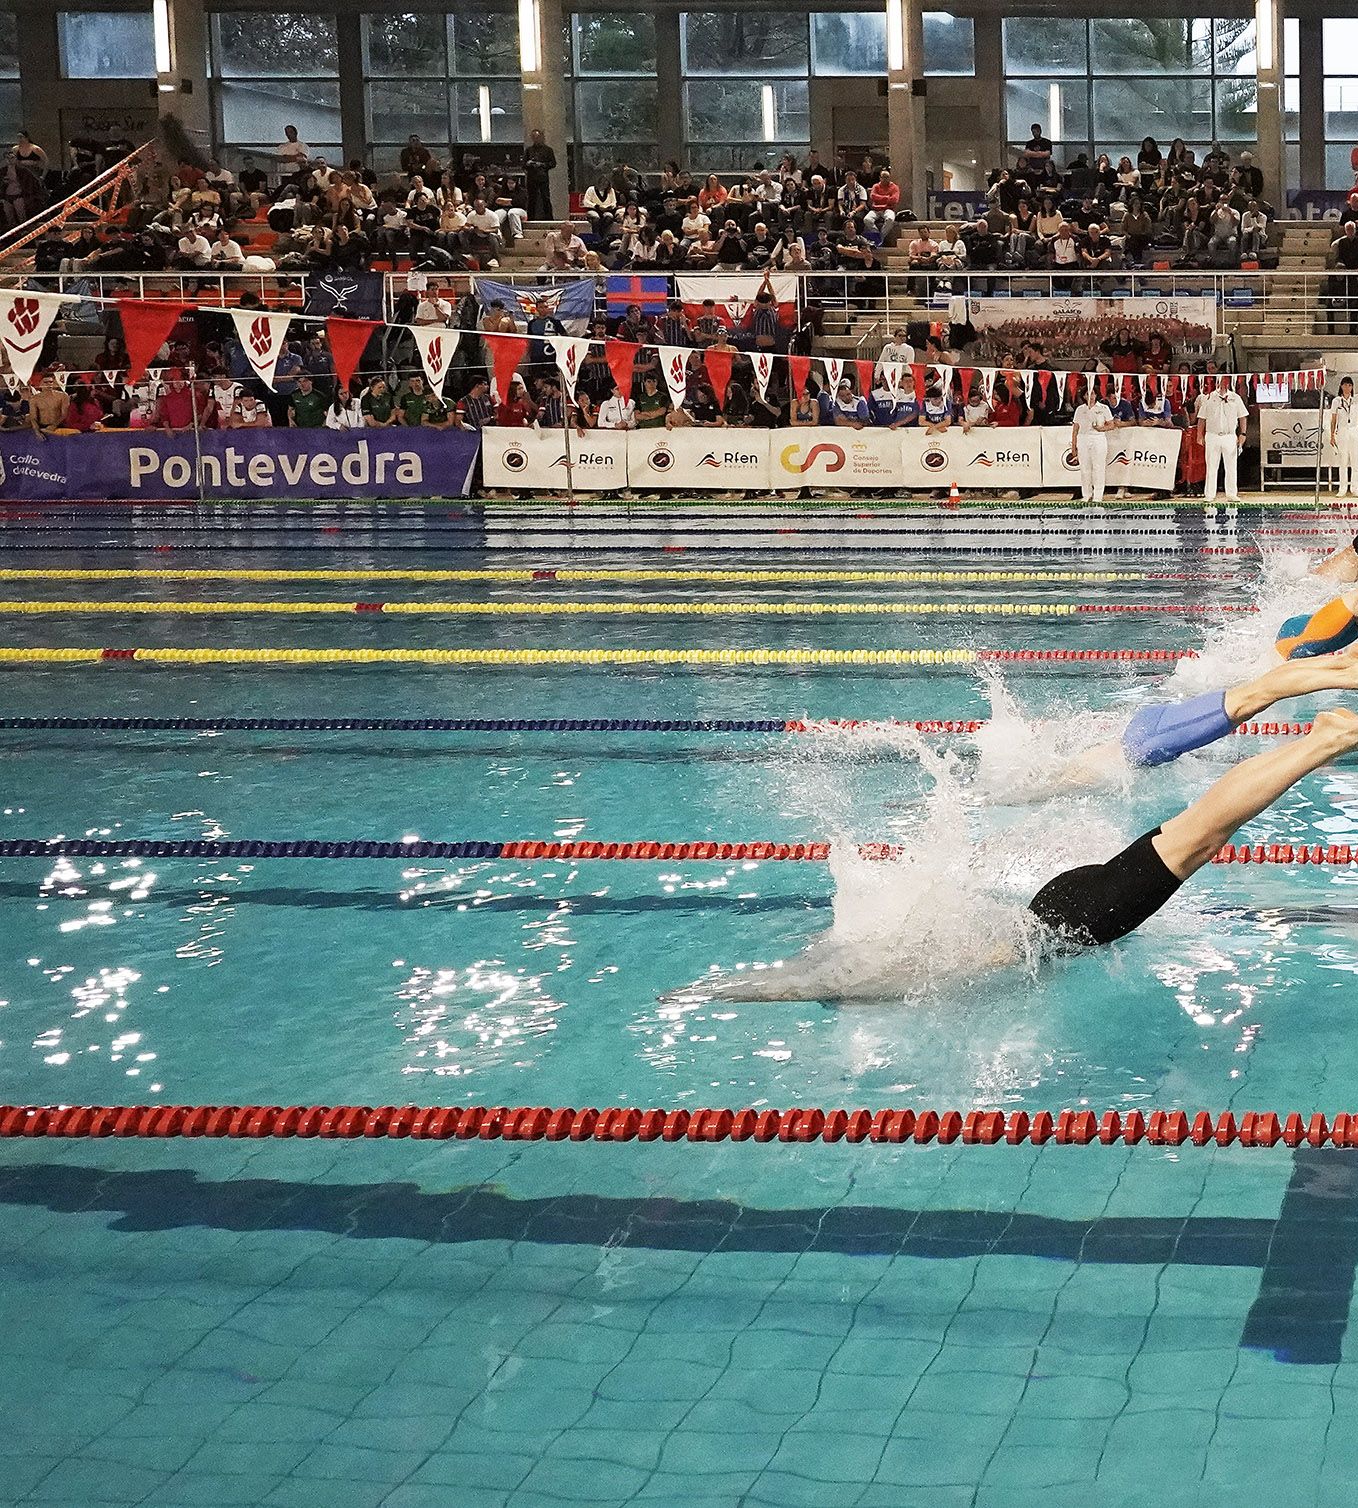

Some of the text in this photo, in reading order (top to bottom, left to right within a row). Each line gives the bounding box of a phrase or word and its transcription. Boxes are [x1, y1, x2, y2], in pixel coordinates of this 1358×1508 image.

[579, 453, 614, 464] Rfen
[724, 452, 758, 463] Rfen
[996, 451, 1030, 462] Rfen
[1134, 451, 1167, 464] Rfen
[130, 440, 424, 488] Pontevedra
